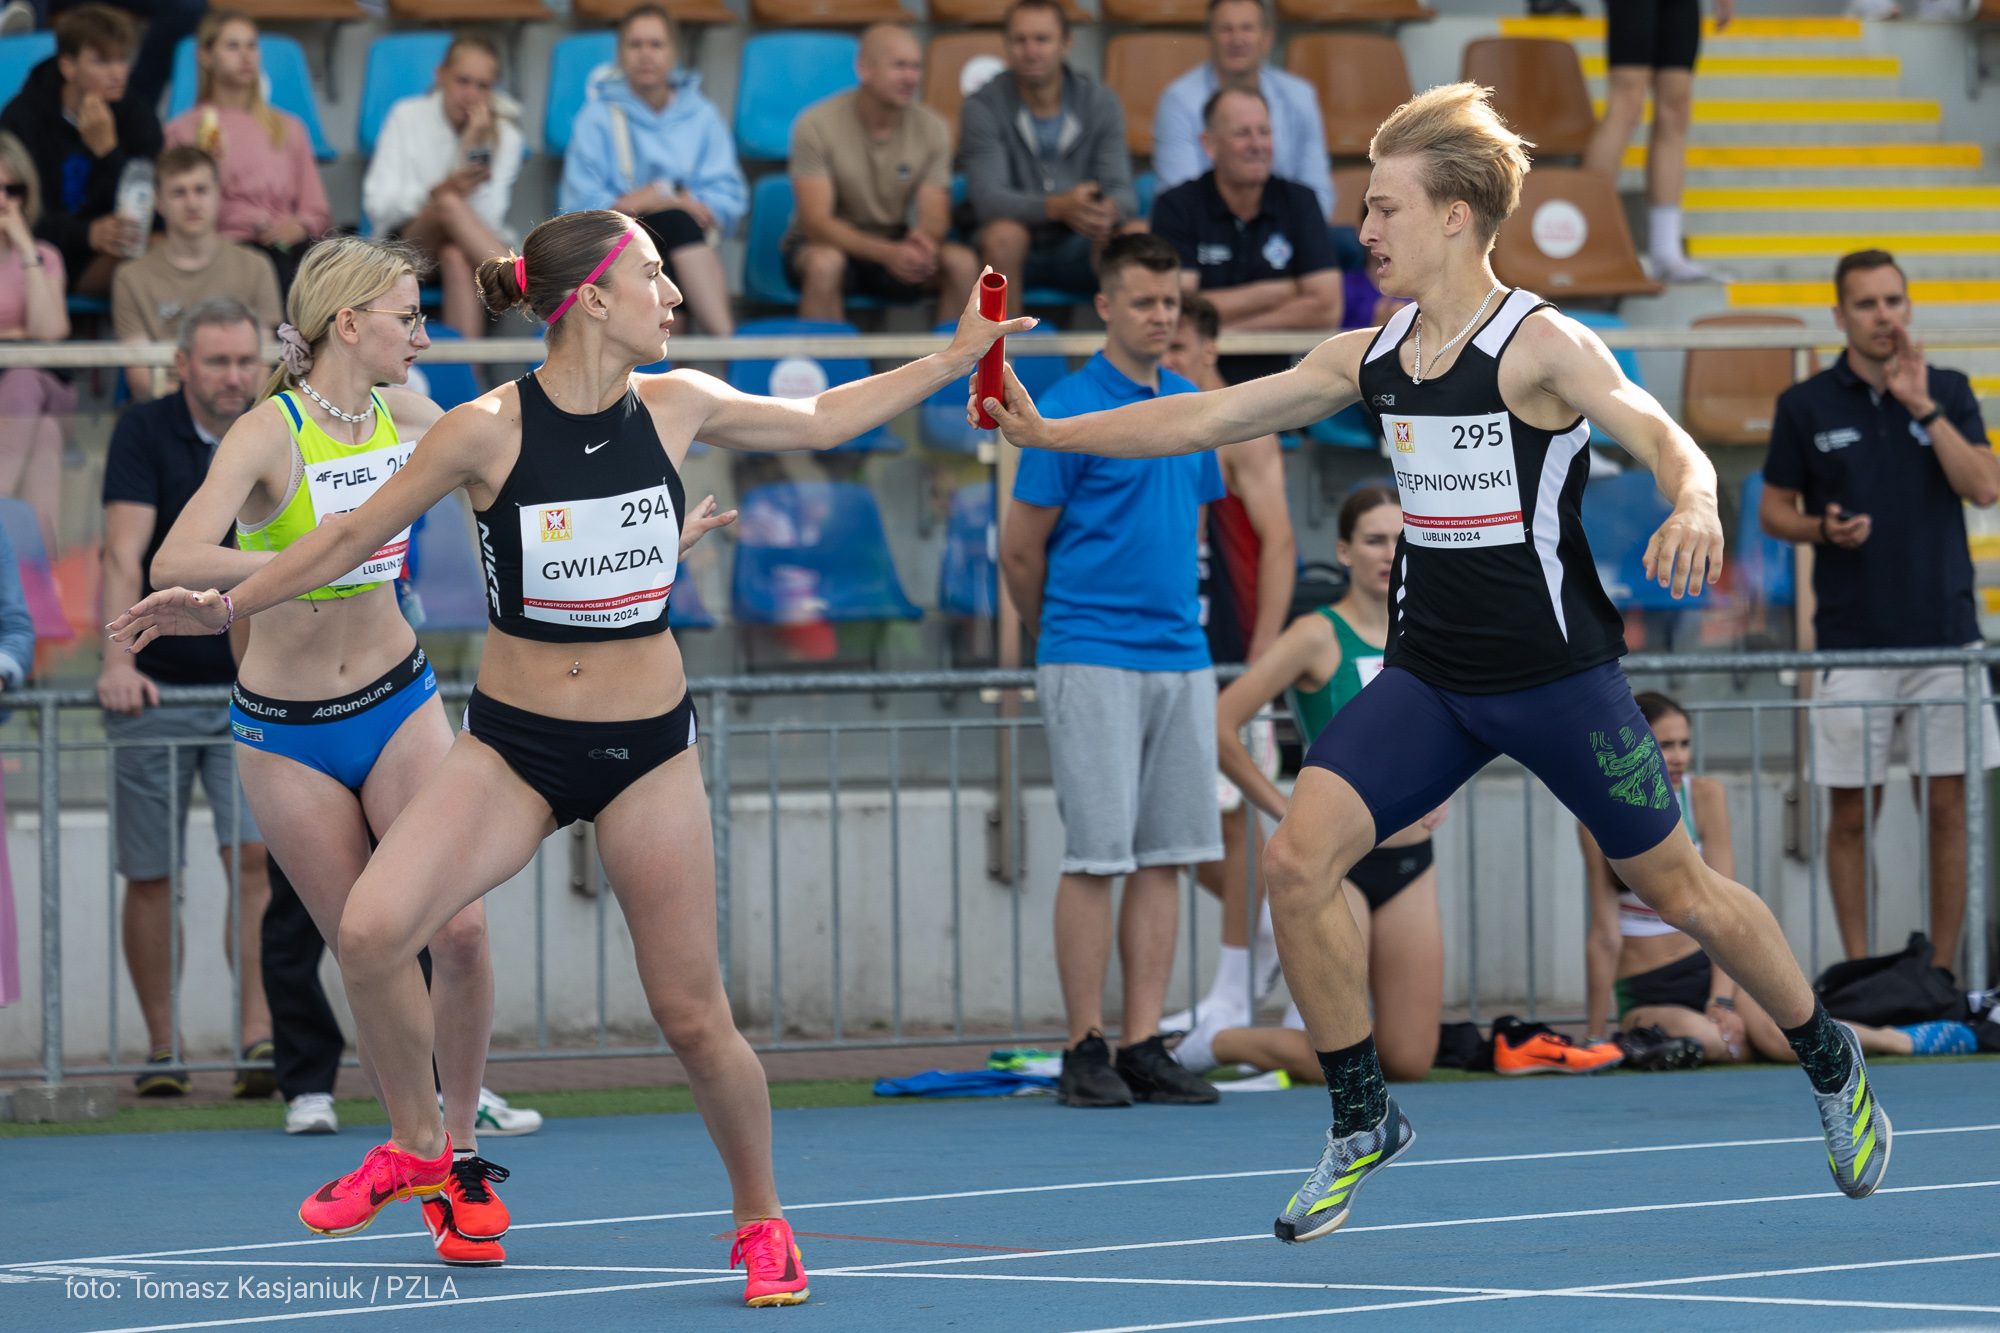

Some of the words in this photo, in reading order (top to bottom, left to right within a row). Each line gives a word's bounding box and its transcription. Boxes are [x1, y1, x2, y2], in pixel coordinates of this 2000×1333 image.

[1451, 421, 1504, 449] 295
[332, 467, 377, 490] FUEL
[1396, 469, 1512, 493] STĘPNIOWSKI
[620, 494, 669, 528] 294
[1482, 514, 1518, 524] MIESZANYCH
[543, 529, 570, 541] PZLA
[1422, 531, 1451, 542] LUBLIN
[1453, 531, 1481, 542] 2024
[363, 560, 397, 575] LUBLIN
[478, 521, 501, 617] NIKE
[542, 545, 664, 580] GWIAZDA
[611, 594, 643, 607] SZTAFETACH
[569, 613, 611, 622] LUBLIN
[613, 607, 639, 622] 2024
